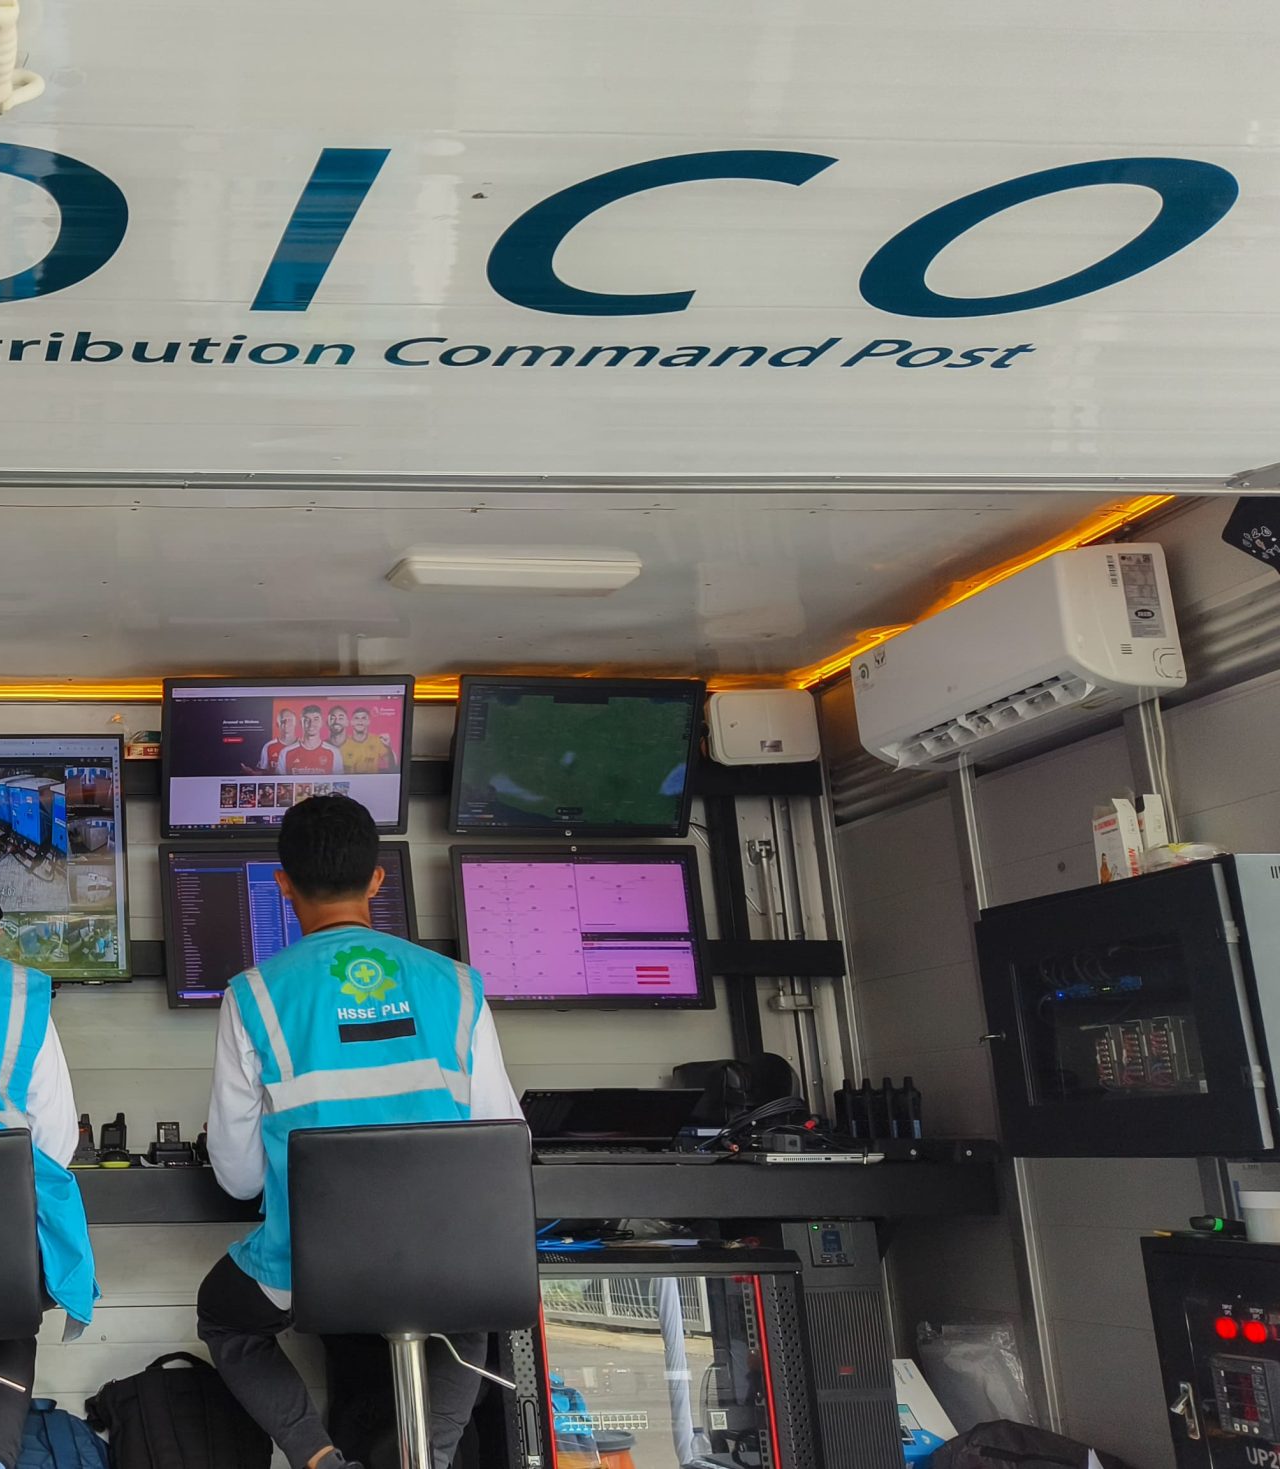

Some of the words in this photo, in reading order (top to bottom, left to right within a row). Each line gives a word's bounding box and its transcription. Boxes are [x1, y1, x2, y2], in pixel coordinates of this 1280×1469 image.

[385, 338, 833, 368] Command
[843, 340, 1034, 369] Post
[337, 1007, 377, 1020] HSSE
[381, 1000, 411, 1017] PLN
[1245, 1445, 1280, 1469] UP2
